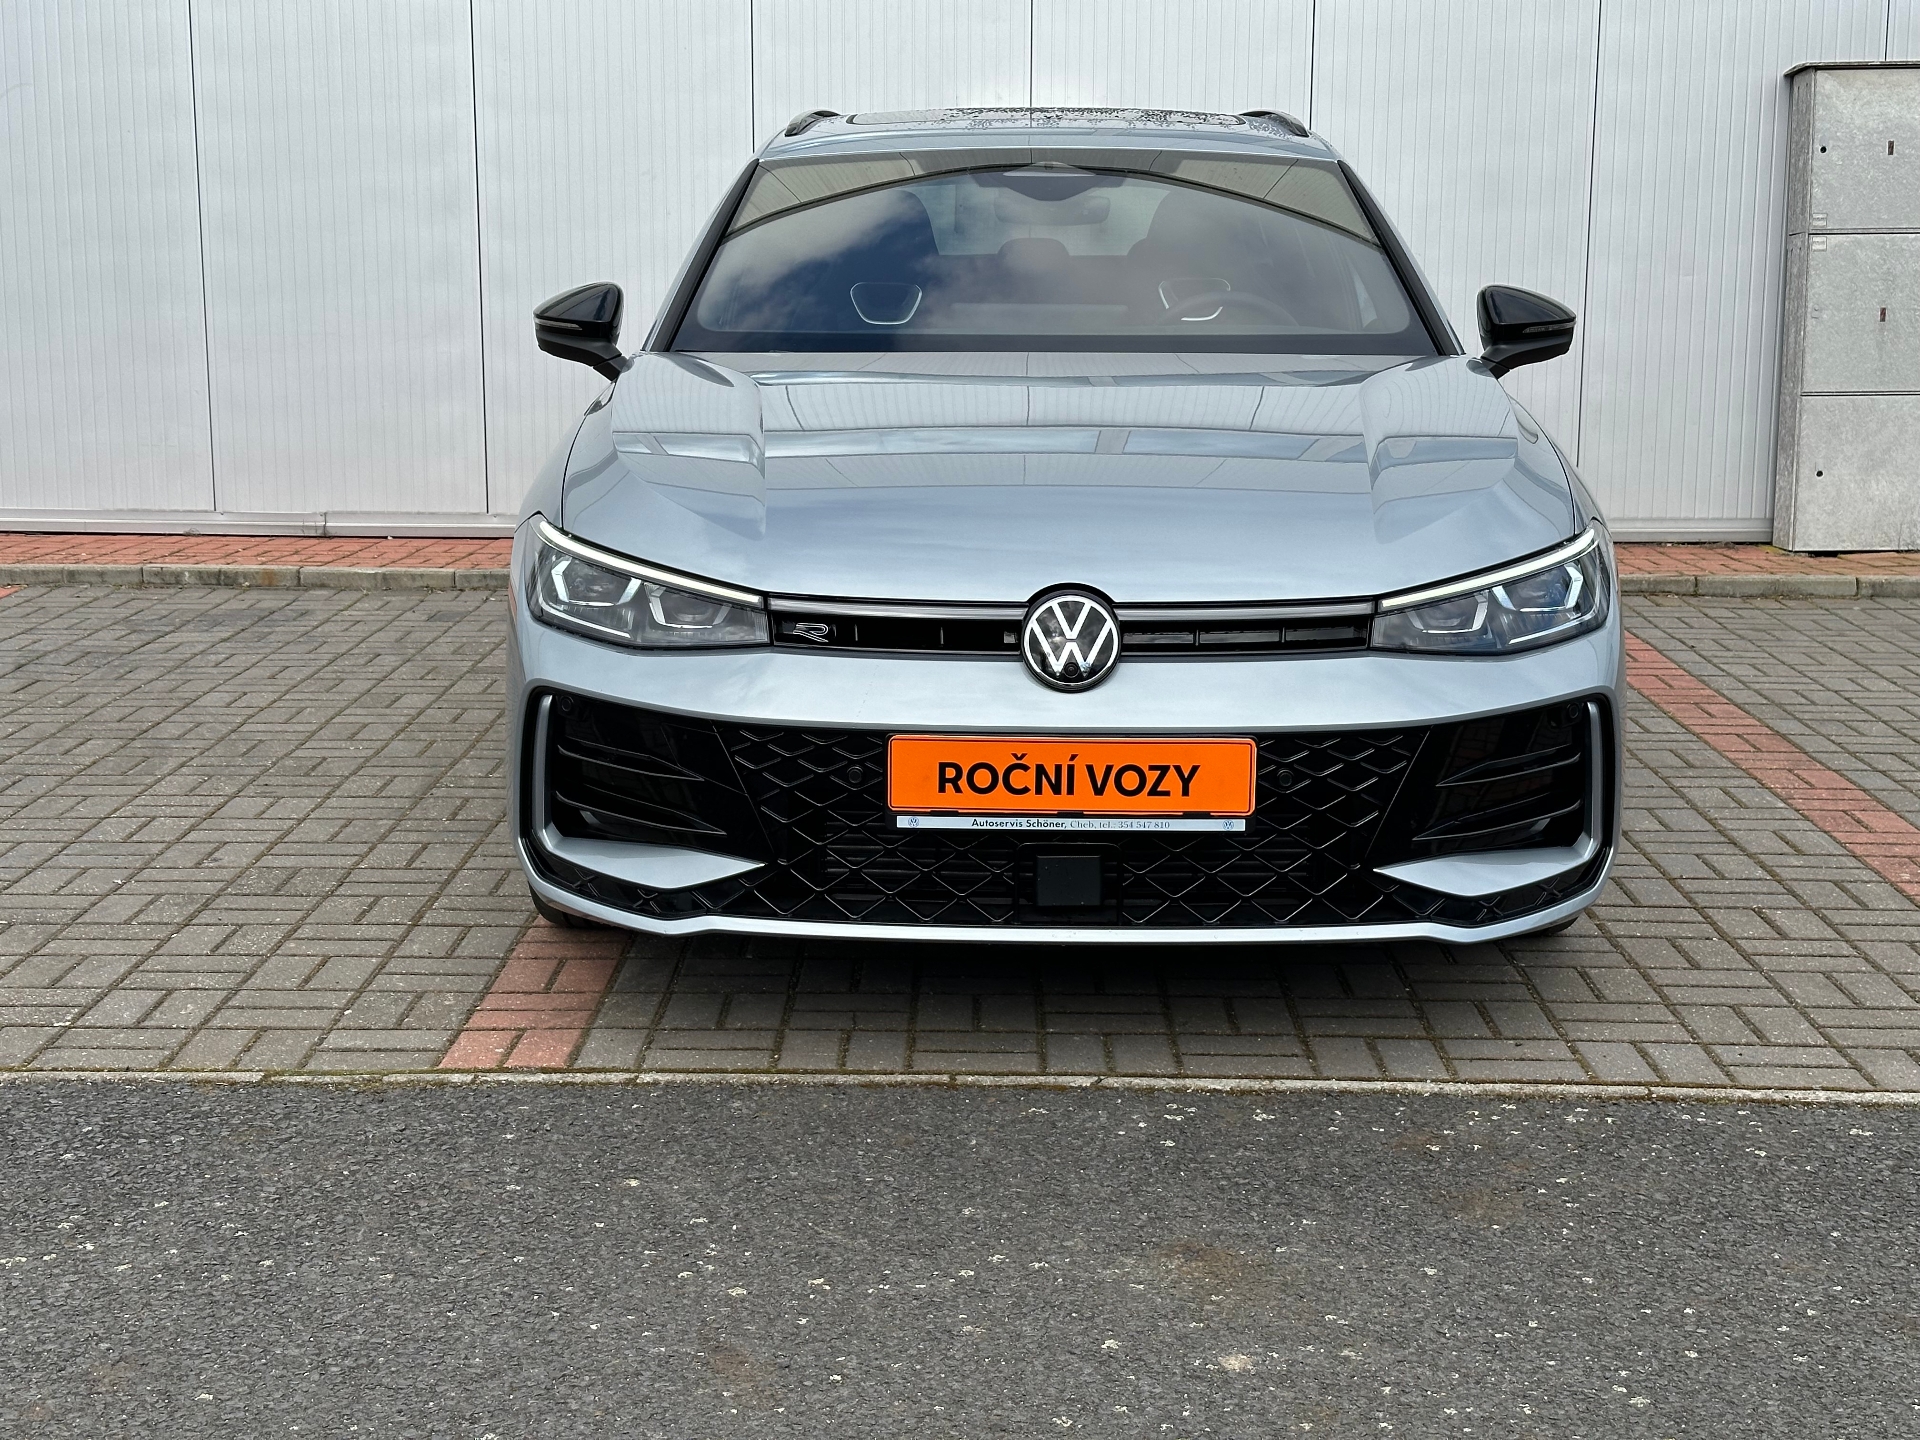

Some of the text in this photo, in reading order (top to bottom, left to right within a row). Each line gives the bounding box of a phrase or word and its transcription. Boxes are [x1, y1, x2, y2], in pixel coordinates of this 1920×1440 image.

[938, 753, 1201, 797] ROČNÍ VOZY
[971, 818, 1023, 828] Autoservis
[1025, 818, 1067, 829] Schöner,
[1069, 820, 1097, 830] Cheb,
[1118, 821, 1134, 830] 354
[1136, 821, 1152, 830] 547
[1154, 821, 1170, 830] 810
